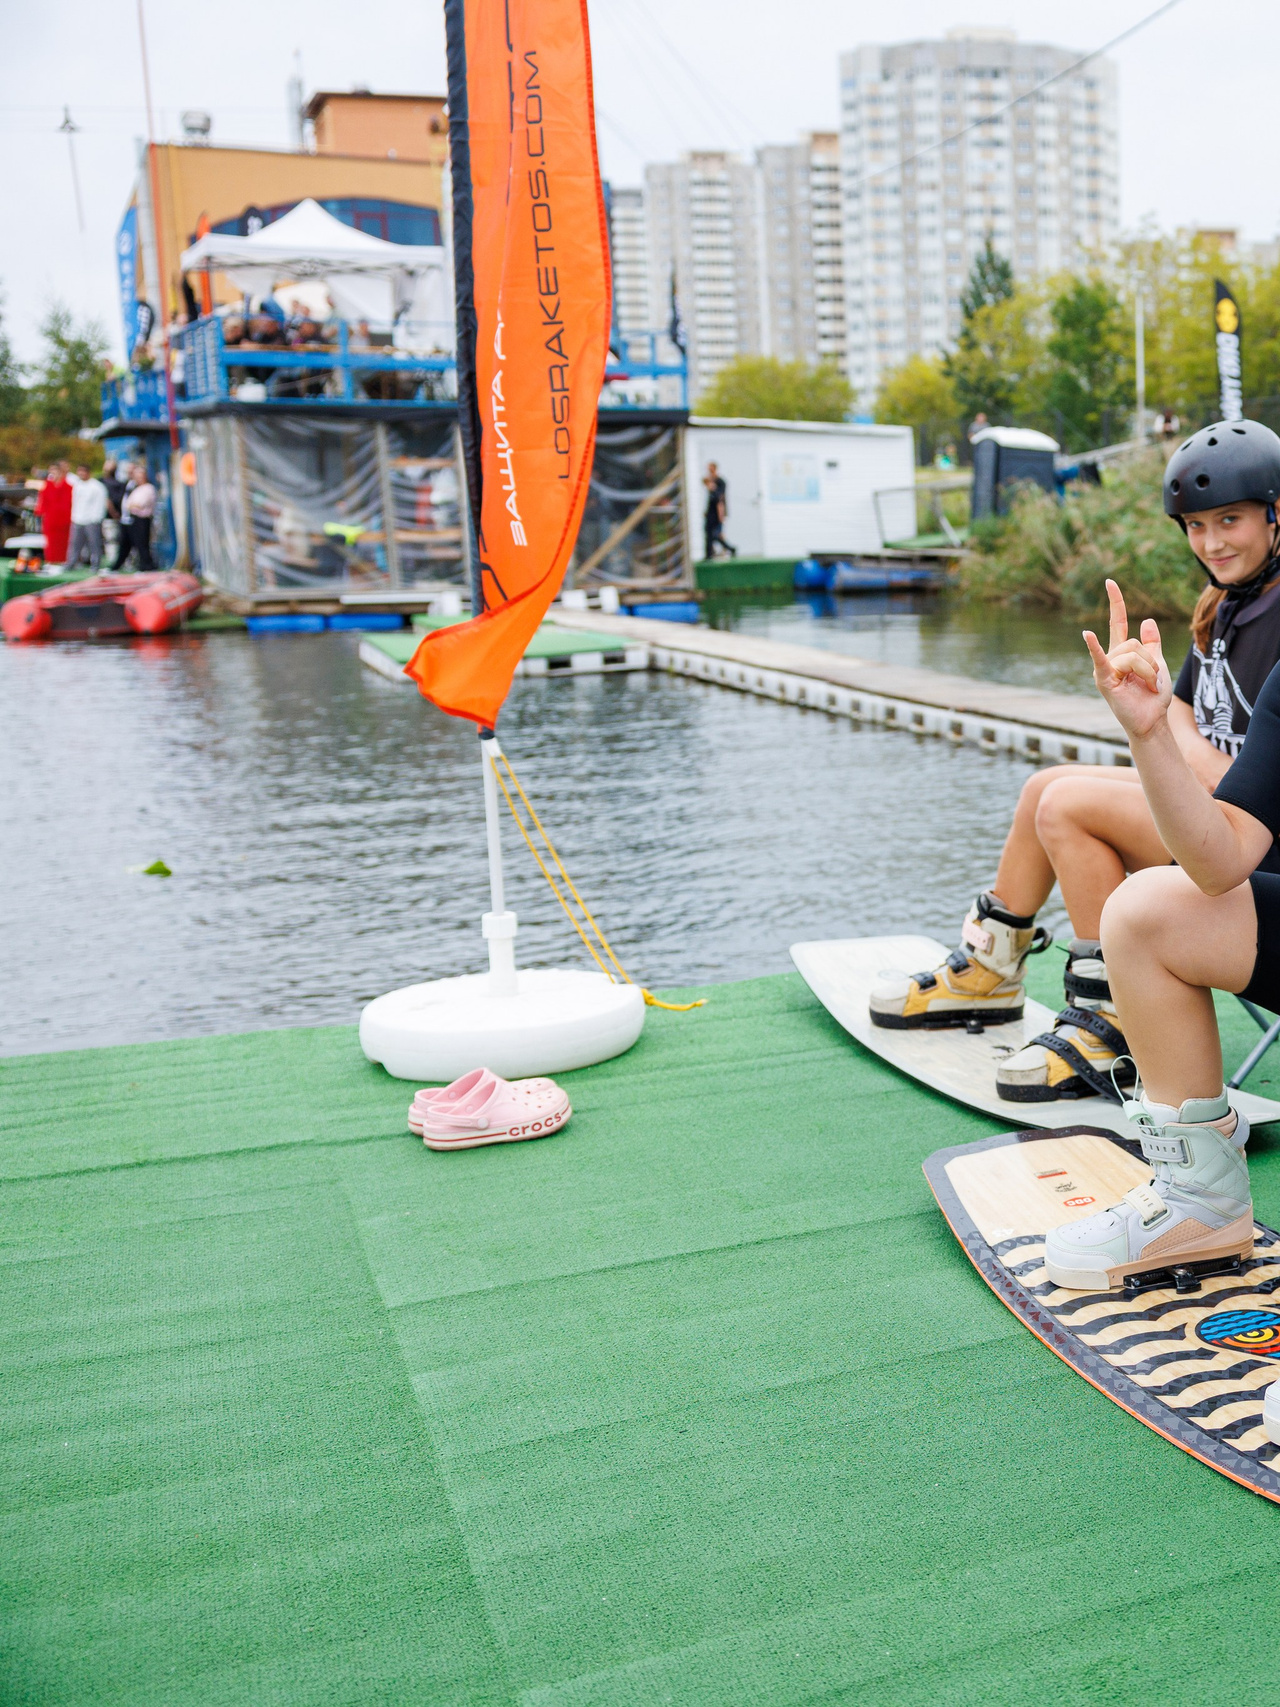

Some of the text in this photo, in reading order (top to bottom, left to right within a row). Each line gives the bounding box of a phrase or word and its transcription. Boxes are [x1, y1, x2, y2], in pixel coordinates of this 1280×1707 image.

[523, 50, 571, 479] LOSRAKETOS.COM
[491, 369, 528, 546] ЗАЩИТА
[508, 1112, 562, 1137] crocs
